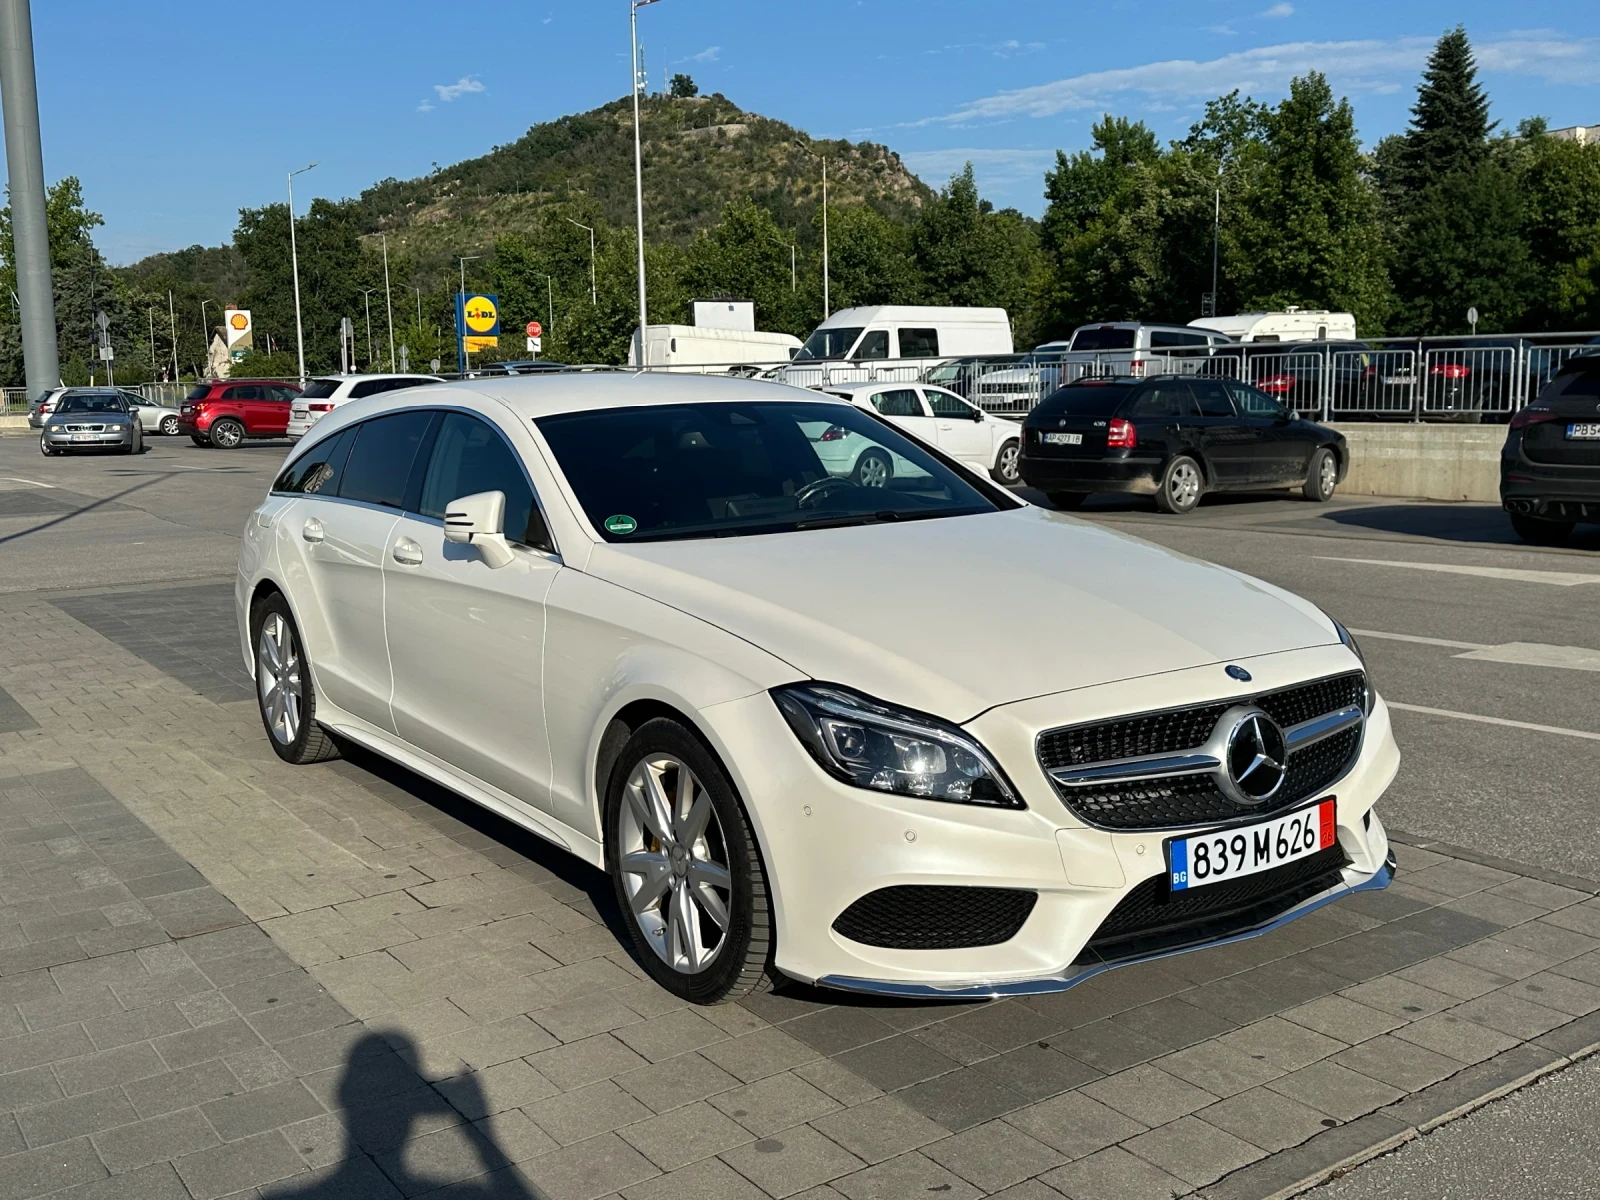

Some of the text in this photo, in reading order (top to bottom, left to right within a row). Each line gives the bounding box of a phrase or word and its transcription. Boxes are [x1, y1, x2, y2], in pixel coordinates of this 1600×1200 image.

[1574, 424, 1588, 435] PB
[1322, 830, 1333, 844] 26
[1193, 813, 1315, 879] 839 M 626
[1173, 871, 1187, 884] BG
